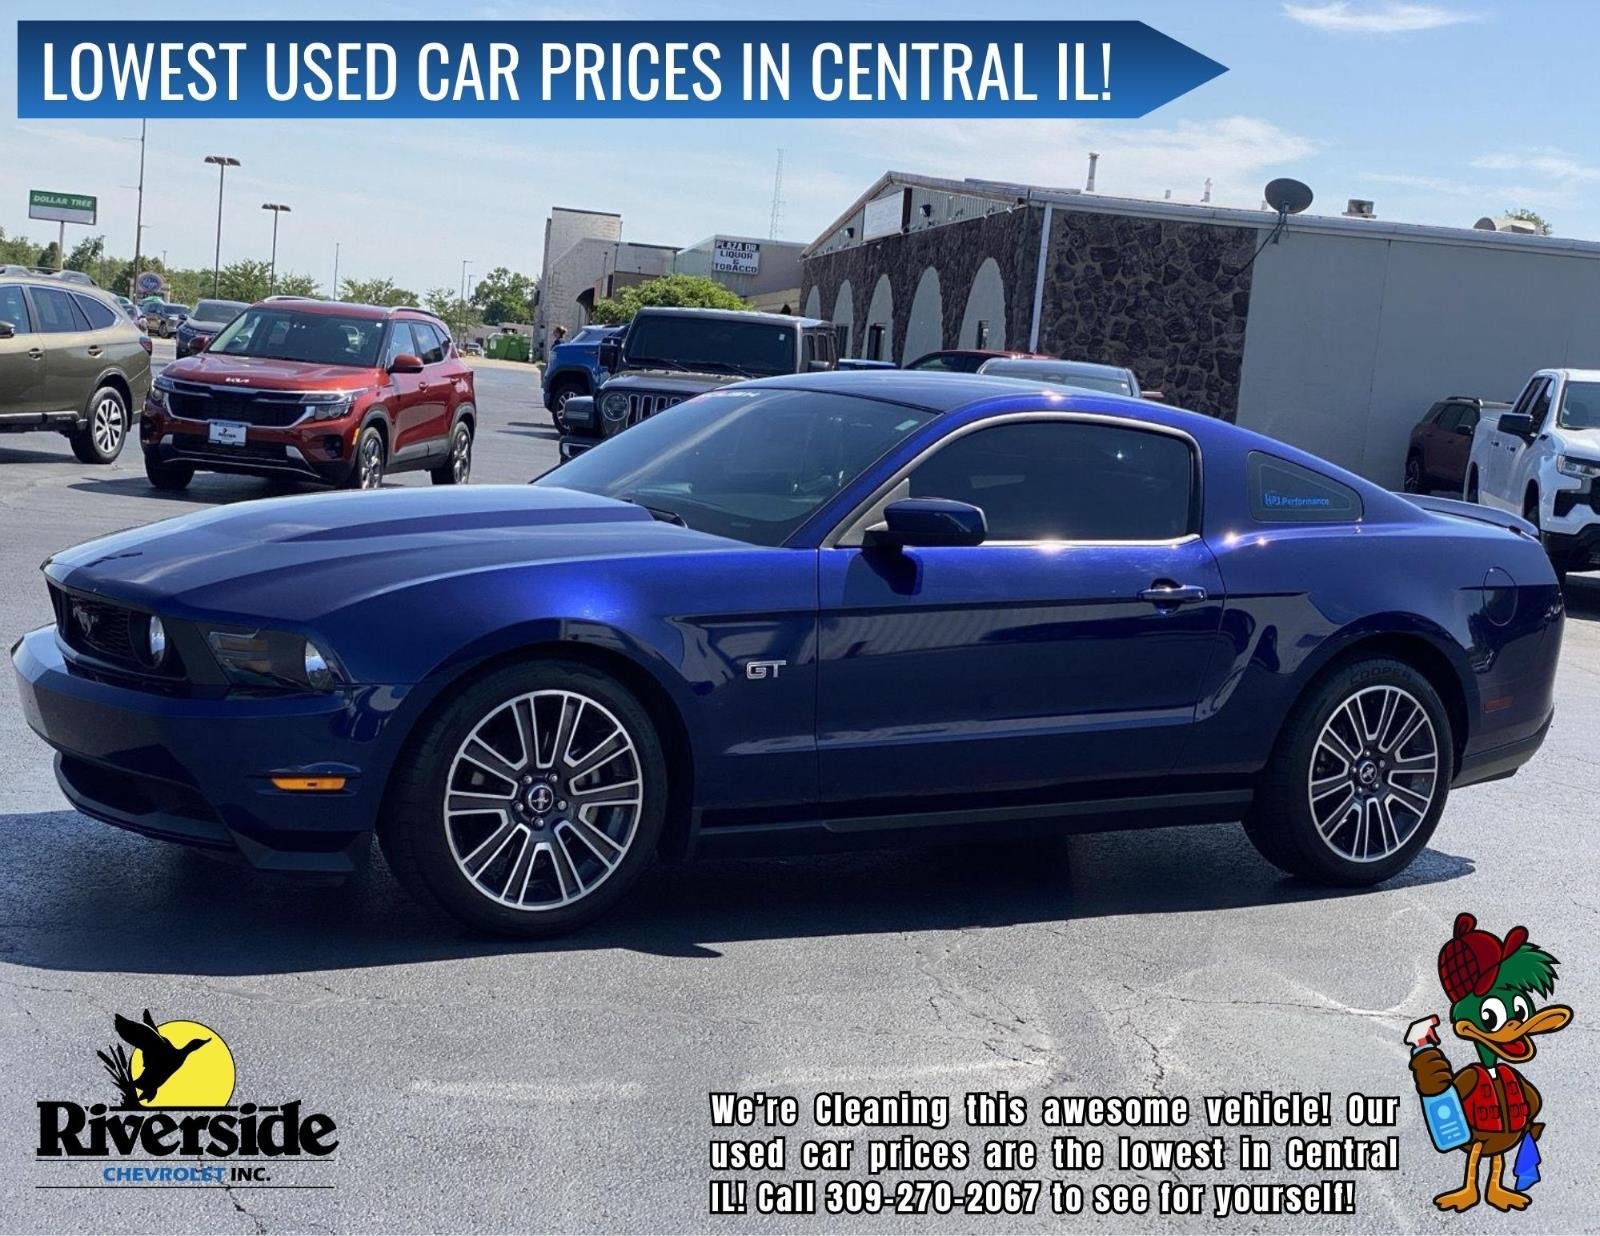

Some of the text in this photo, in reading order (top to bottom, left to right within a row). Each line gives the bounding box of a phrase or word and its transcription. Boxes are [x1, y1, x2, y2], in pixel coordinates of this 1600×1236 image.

[33, 194, 93, 207] DOLLAR TREE
[716, 240, 743, 250] PLAZA
[720, 250, 753, 259] LIQUOR
[714, 263, 757, 273] TOBACCO
[746, 660, 787, 679] GT
